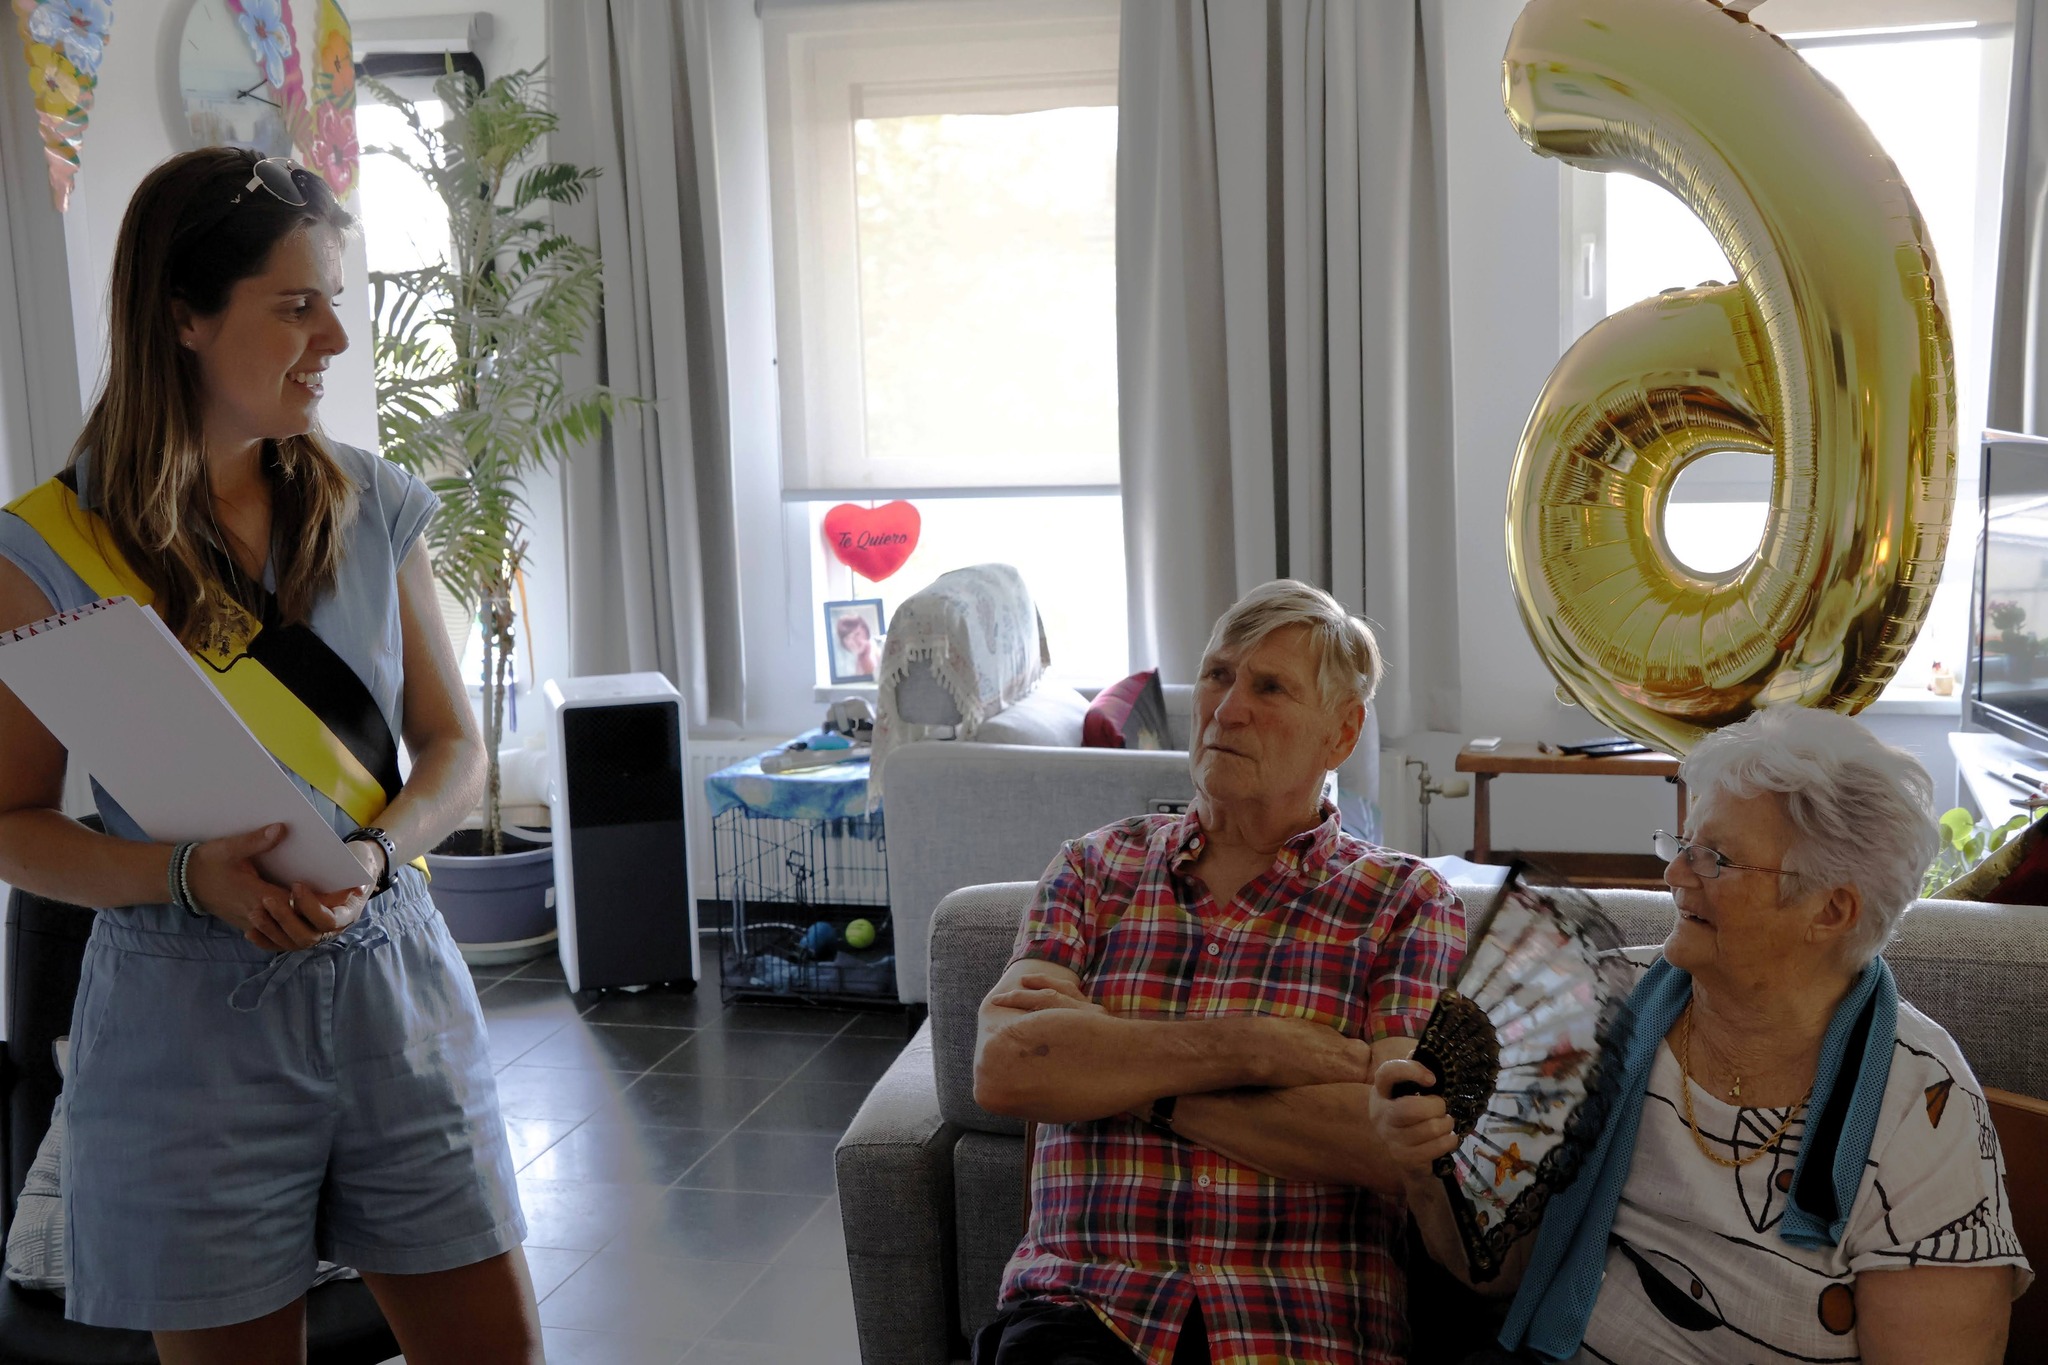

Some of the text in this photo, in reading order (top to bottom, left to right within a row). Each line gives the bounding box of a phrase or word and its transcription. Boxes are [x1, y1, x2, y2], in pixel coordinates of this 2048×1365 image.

[838, 530, 907, 550] Te Quiero
[1501, 0, 1958, 757] 6
